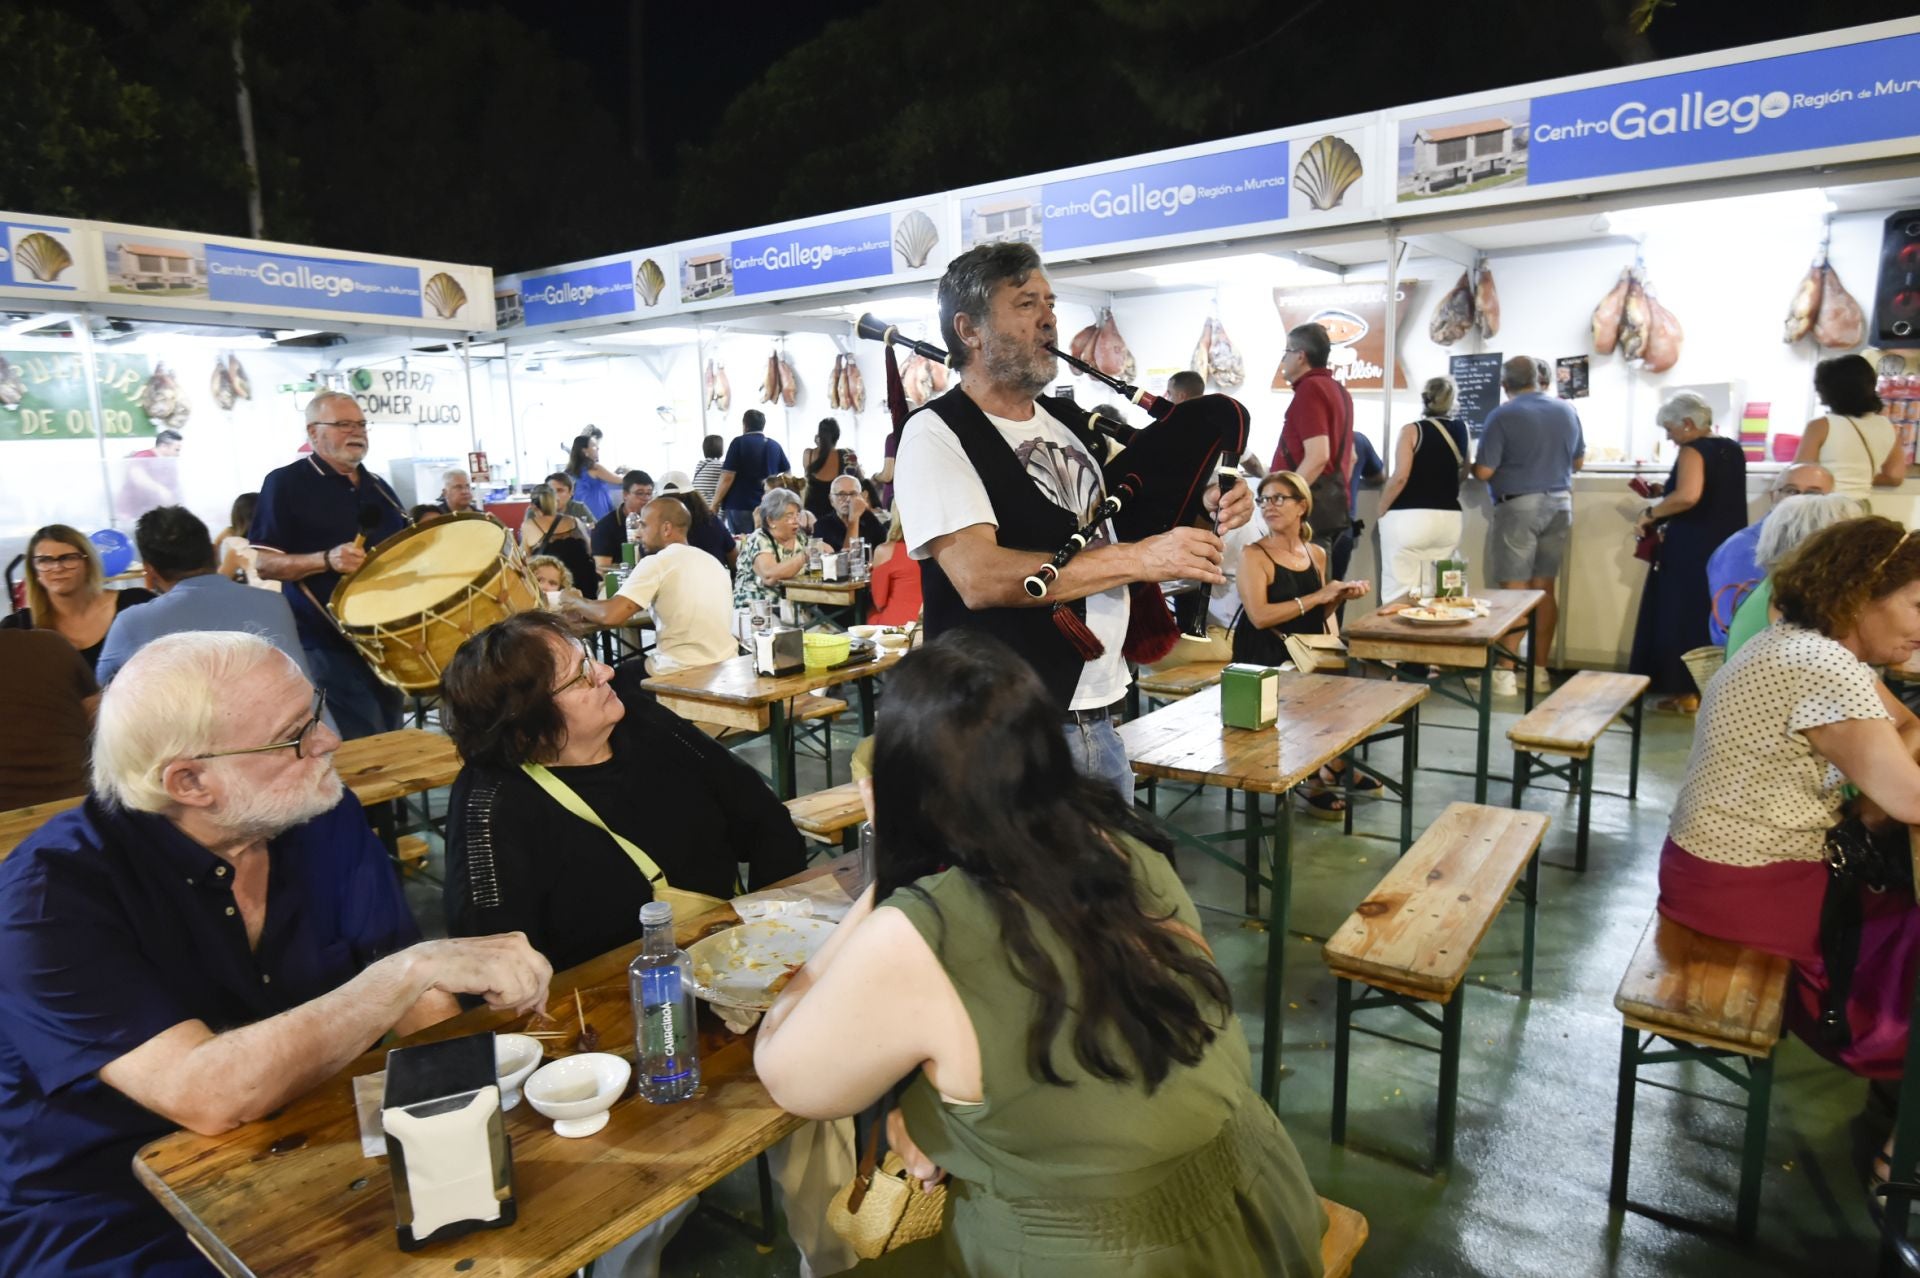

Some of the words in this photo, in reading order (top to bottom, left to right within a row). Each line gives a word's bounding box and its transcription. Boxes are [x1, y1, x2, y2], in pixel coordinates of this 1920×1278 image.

[1534, 119, 1609, 143] Centro
[1610, 91, 1791, 141] Gallego
[1792, 88, 1853, 109] Región
[1857, 89, 1872, 99] de
[1044, 202, 1090, 219] Centro
[1090, 182, 1197, 219] Gallego
[1197, 184, 1233, 199] Región
[1244, 177, 1286, 191] Murcia
[733, 256, 764, 270] Centro
[763, 242, 833, 271] Gallego
[209, 262, 258, 278] Centro
[257, 262, 355, 298] Gallego
[545, 282, 593, 305] Gallego
[382, 371, 434, 393] PARA
[20, 408, 57, 435] DE
[355, 394, 412, 414] COMER
[418, 405, 461, 423] LUGO
